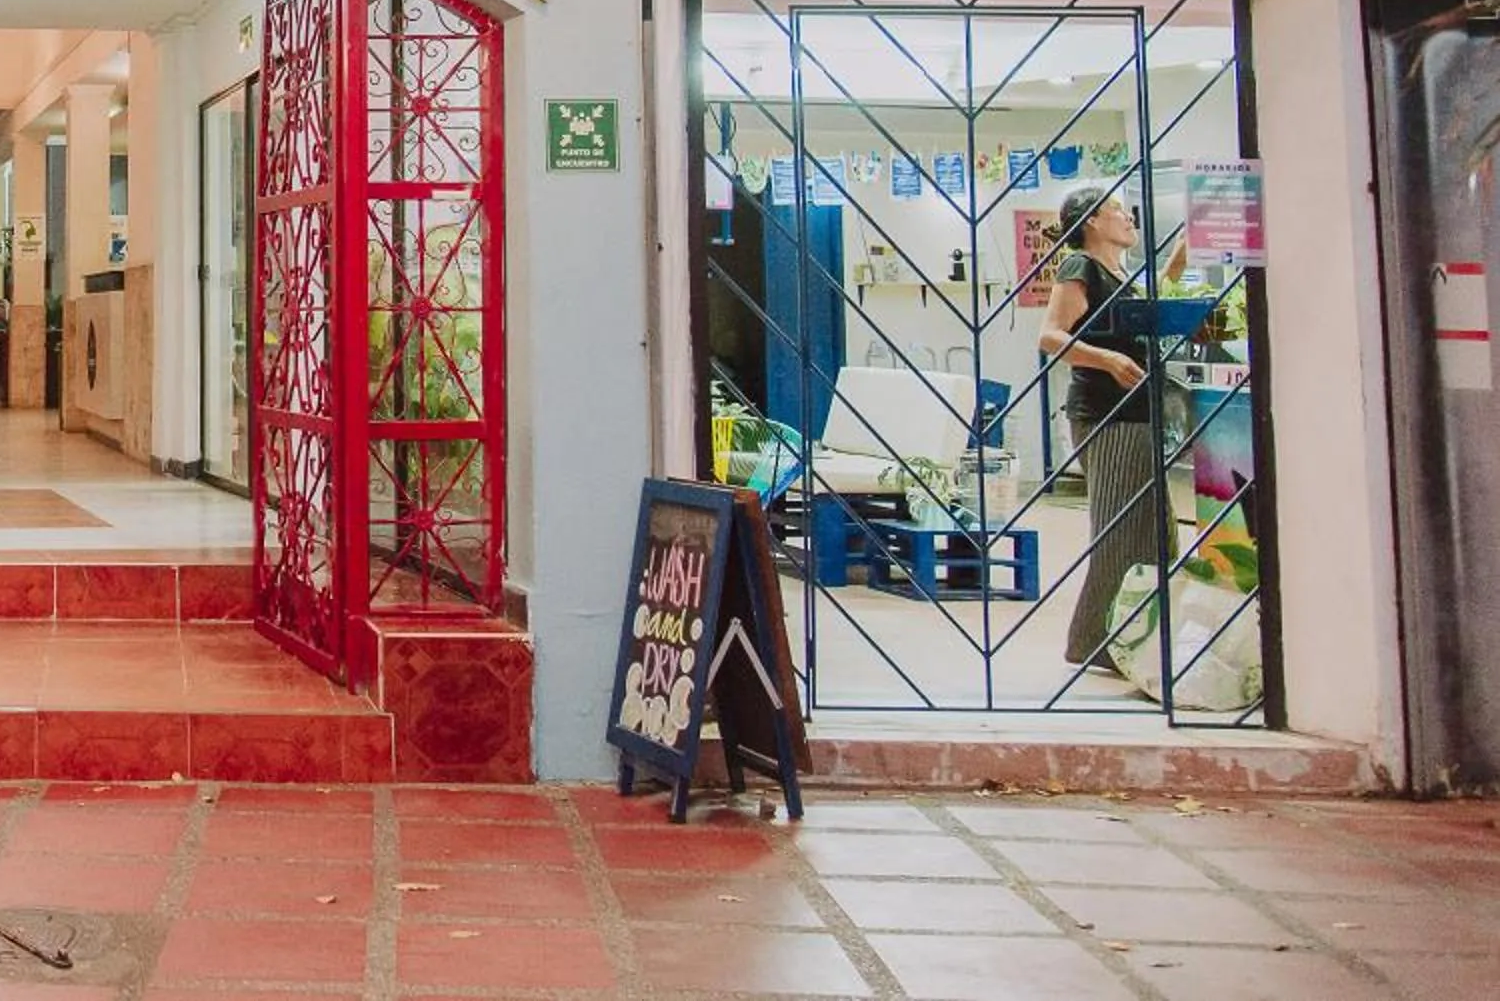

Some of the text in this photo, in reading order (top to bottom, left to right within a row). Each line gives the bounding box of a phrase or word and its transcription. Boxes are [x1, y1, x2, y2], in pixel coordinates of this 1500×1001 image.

[647, 545, 705, 608] WASH
[645, 607, 687, 645] and
[641, 642, 680, 694] DRY
